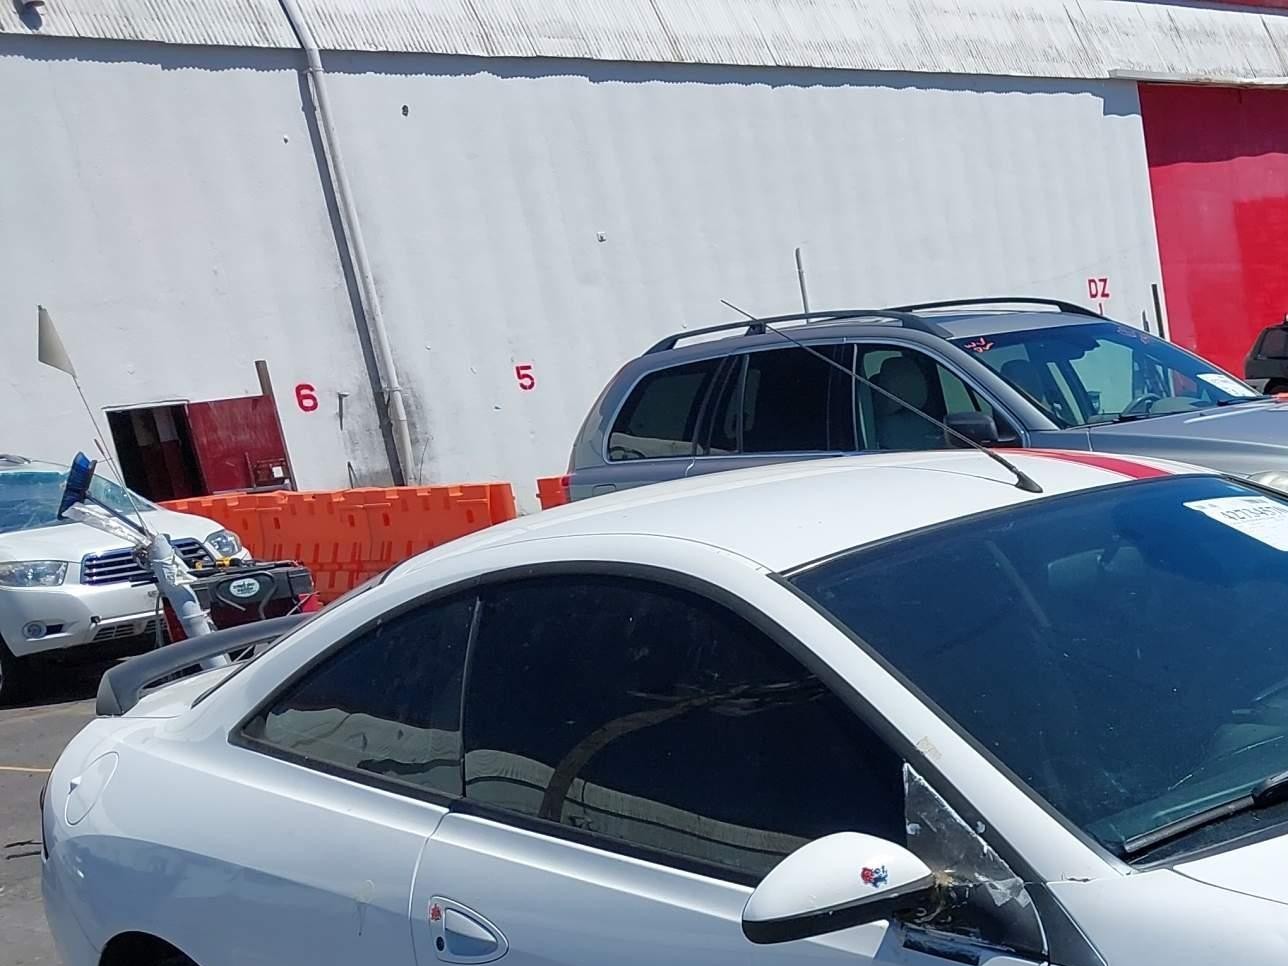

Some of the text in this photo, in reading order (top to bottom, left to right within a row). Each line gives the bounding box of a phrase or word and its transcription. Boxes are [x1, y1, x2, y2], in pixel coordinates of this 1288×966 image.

[1087, 278, 1110, 299] DZ
[515, 365, 535, 390] 5
[295, 383, 319, 413] 6
